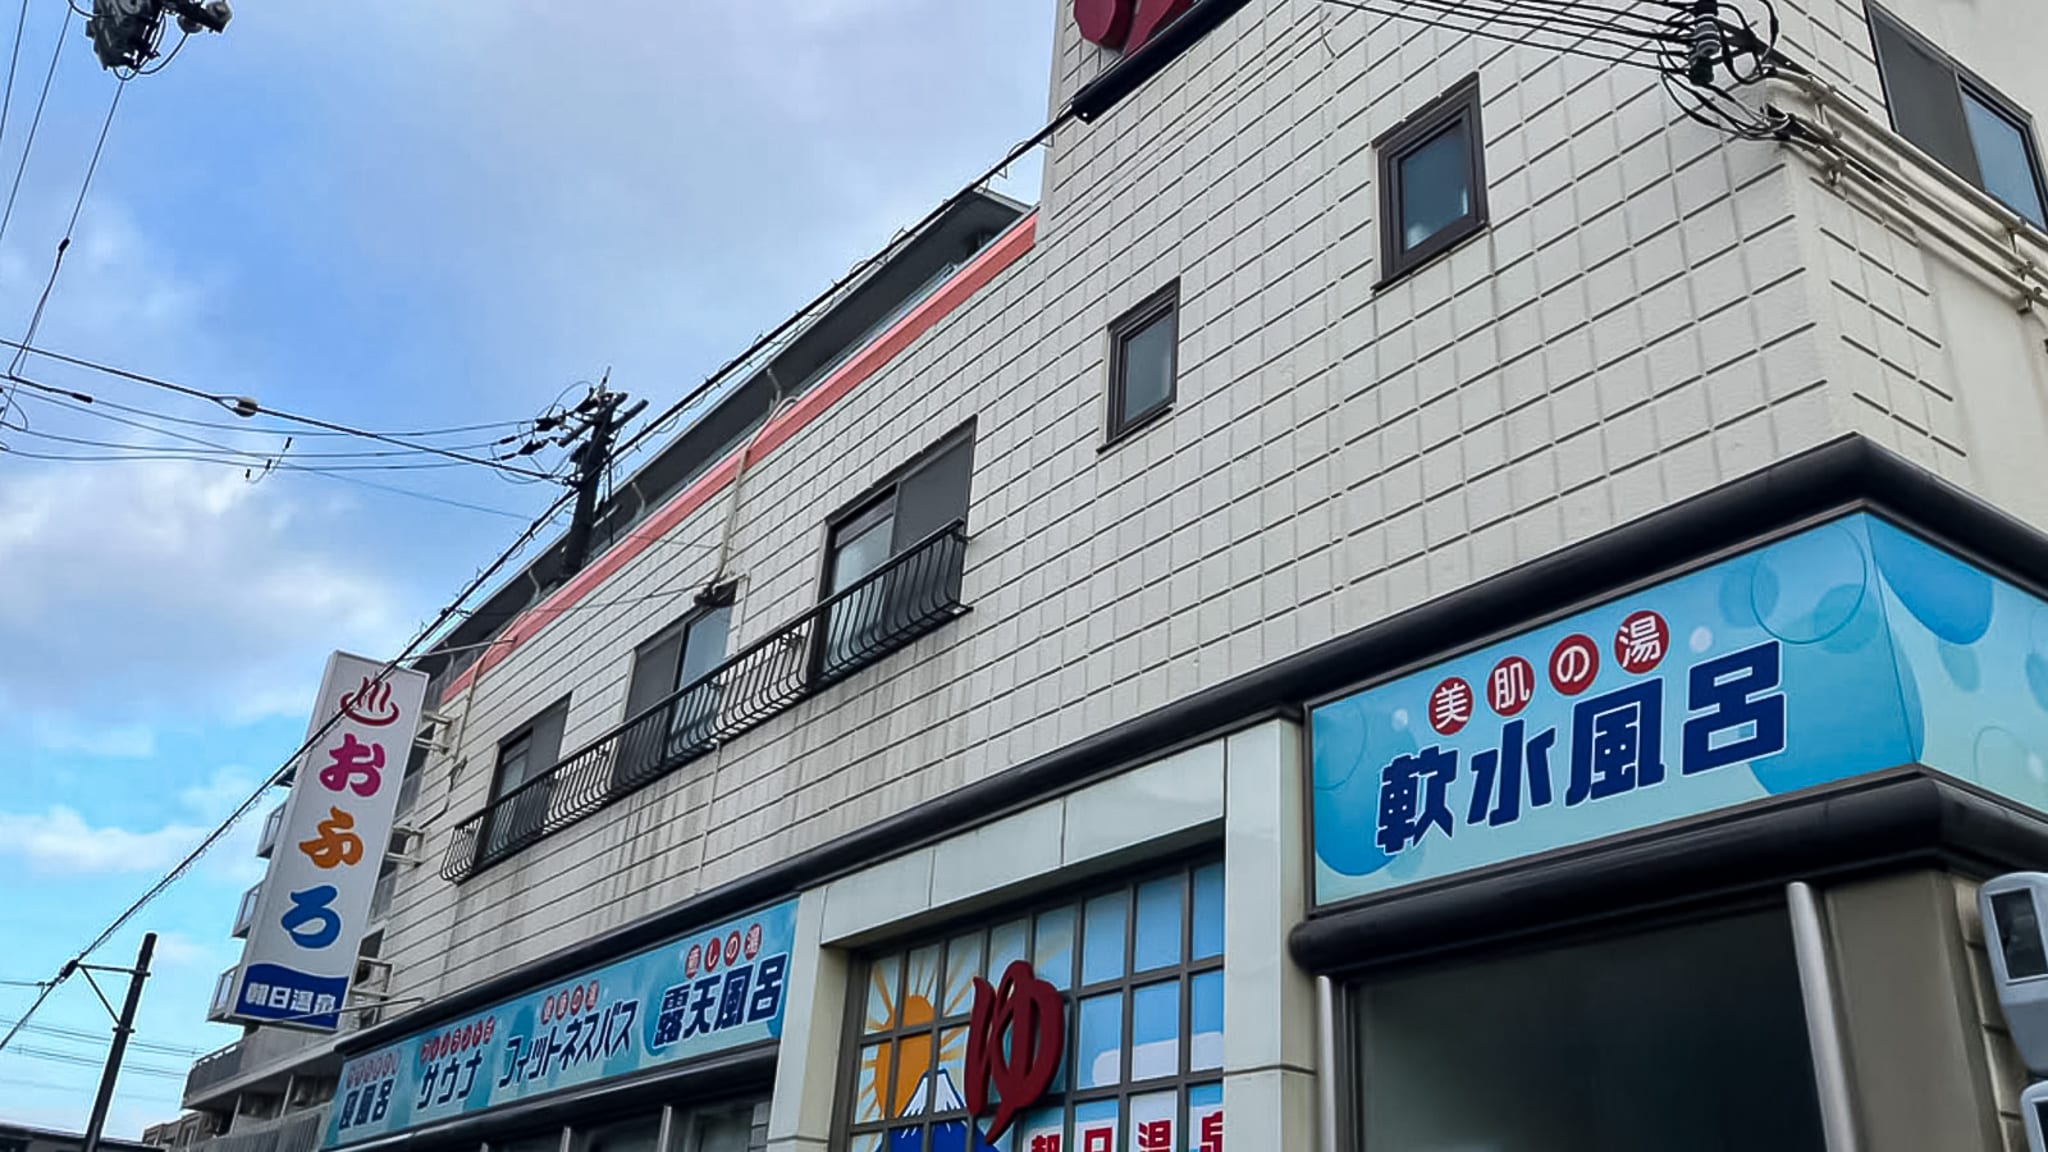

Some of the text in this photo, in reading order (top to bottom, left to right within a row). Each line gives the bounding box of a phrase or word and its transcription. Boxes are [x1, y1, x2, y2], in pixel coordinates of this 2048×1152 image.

[1431, 614, 1664, 732] 美肌の湯
[1376, 640, 1787, 855] 軟水風呂
[282, 733, 386, 949] おふろ
[499, 1000, 640, 1088] フィットネスバス
[651, 953, 789, 1049] 露天風呂
[964, 959, 1066, 1146] ゆ
[417, 1049, 483, 1110] サウナ
